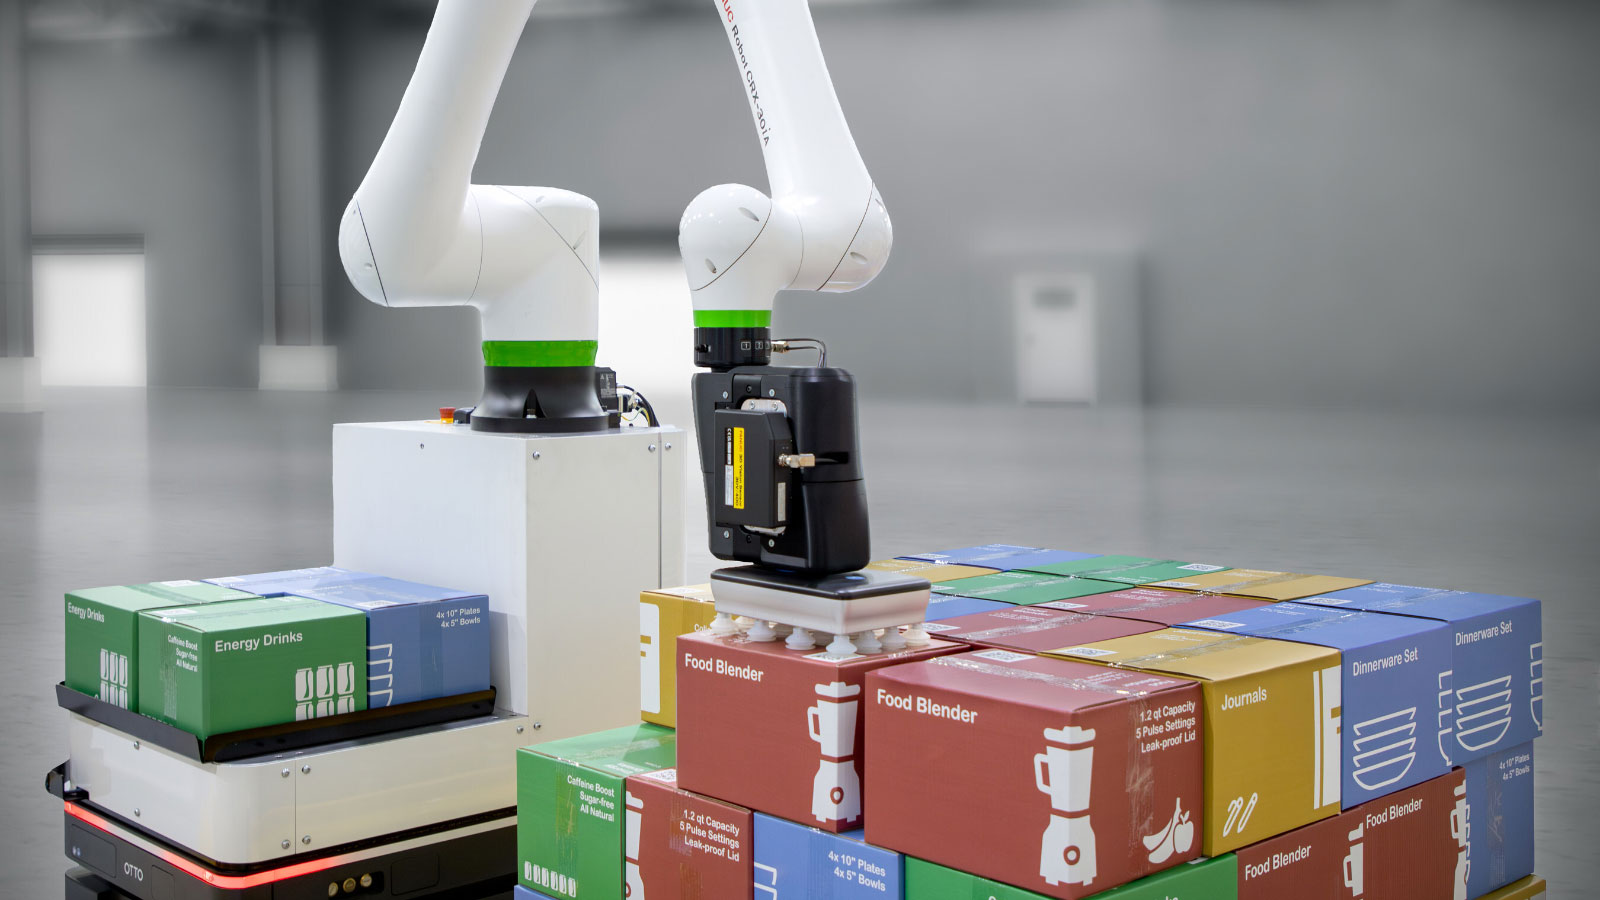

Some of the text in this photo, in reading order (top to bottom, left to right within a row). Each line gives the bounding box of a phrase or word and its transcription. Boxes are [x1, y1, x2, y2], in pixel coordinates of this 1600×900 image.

[732, 24, 748, 69] Robot
[746, 70, 771, 147] CRX-30iA
[68, 602, 105, 623] Energy Drinks
[436, 611, 445, 620] 4x
[460, 608, 480, 616] Plates
[441, 620, 450, 628] 4x
[460, 616, 480, 626] Bowls
[168, 634, 198, 651] Caffeine Boost
[215, 632, 303, 653] Energy Drinks
[1455, 620, 1513, 646] Dinnerware Set
[175, 647, 198, 662] Sugar-free
[183, 660, 198, 673] Natural
[1353, 647, 1419, 677] Dinnerware Set
[685, 652, 764, 682] Food Blender
[877, 688, 978, 724] Food Blender
[1221, 686, 1268, 711] Journals
[1139, 701, 1196, 722] 1.2 qt Capacity
[1136, 717, 1196, 739] 5 Pulse Settings
[1141, 730, 1196, 754] Leak-proof Lid
[567, 774, 615, 798] Caffeine Boost
[580, 790, 615, 810] Sugar-free
[580, 803, 615, 822] All Natural
[684, 809, 740, 837] 1.2 qt Capacity
[1366, 798, 1423, 829] Food Blender
[679, 820, 740, 850] 5 Pulse Settings
[684, 835, 740, 862] Leak-proof Lid
[124, 862, 144, 882] OTTO
[828, 850, 839, 863] 4x
[858, 858, 886, 877] Plates
[1245, 845, 1312, 881] Food Blender
[834, 866, 845, 879] 4x
[858, 873, 886, 892] Bowls
